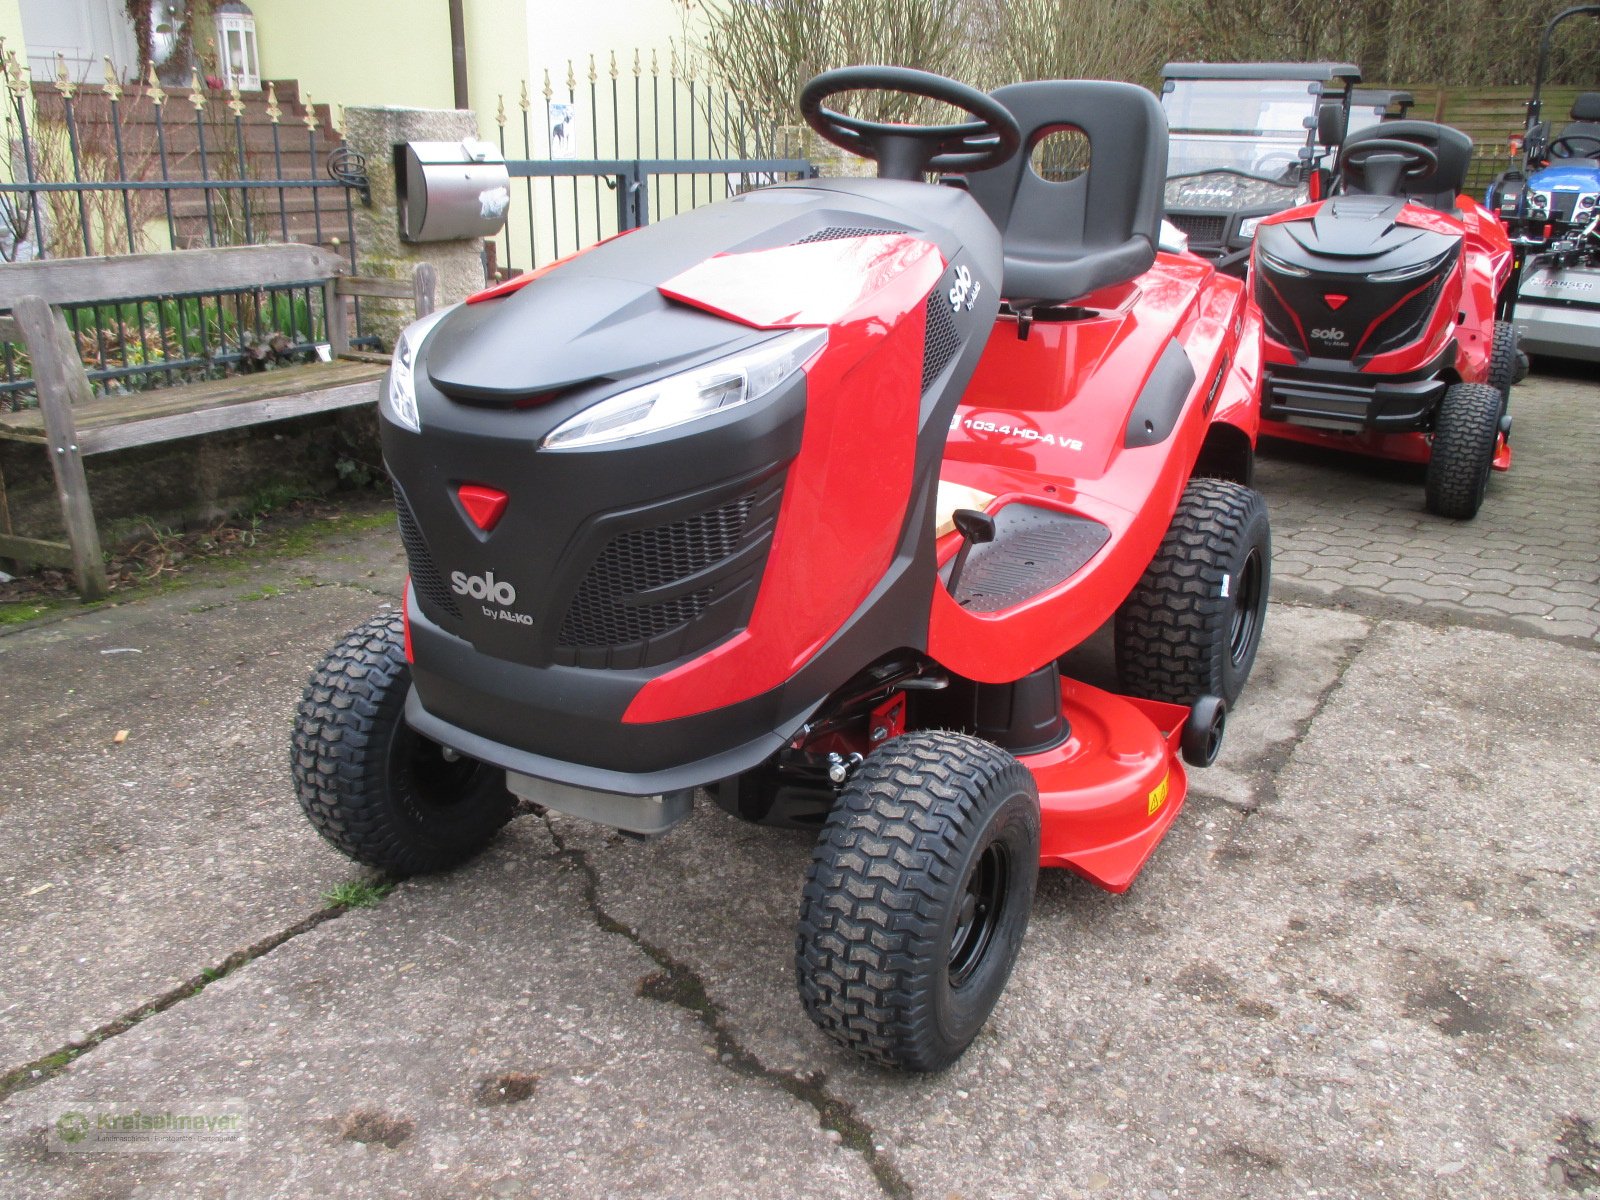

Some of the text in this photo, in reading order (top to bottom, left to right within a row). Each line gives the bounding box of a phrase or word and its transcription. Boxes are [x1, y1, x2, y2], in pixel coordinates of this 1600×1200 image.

[949, 264, 972, 312] solo
[1310, 327, 1345, 340] solo
[964, 419, 1010, 435] 103.4
[1012, 427, 1056, 446] HD-A
[1059, 436, 1083, 451] V2
[451, 570, 516, 606] solo
[481, 605, 498, 620] by
